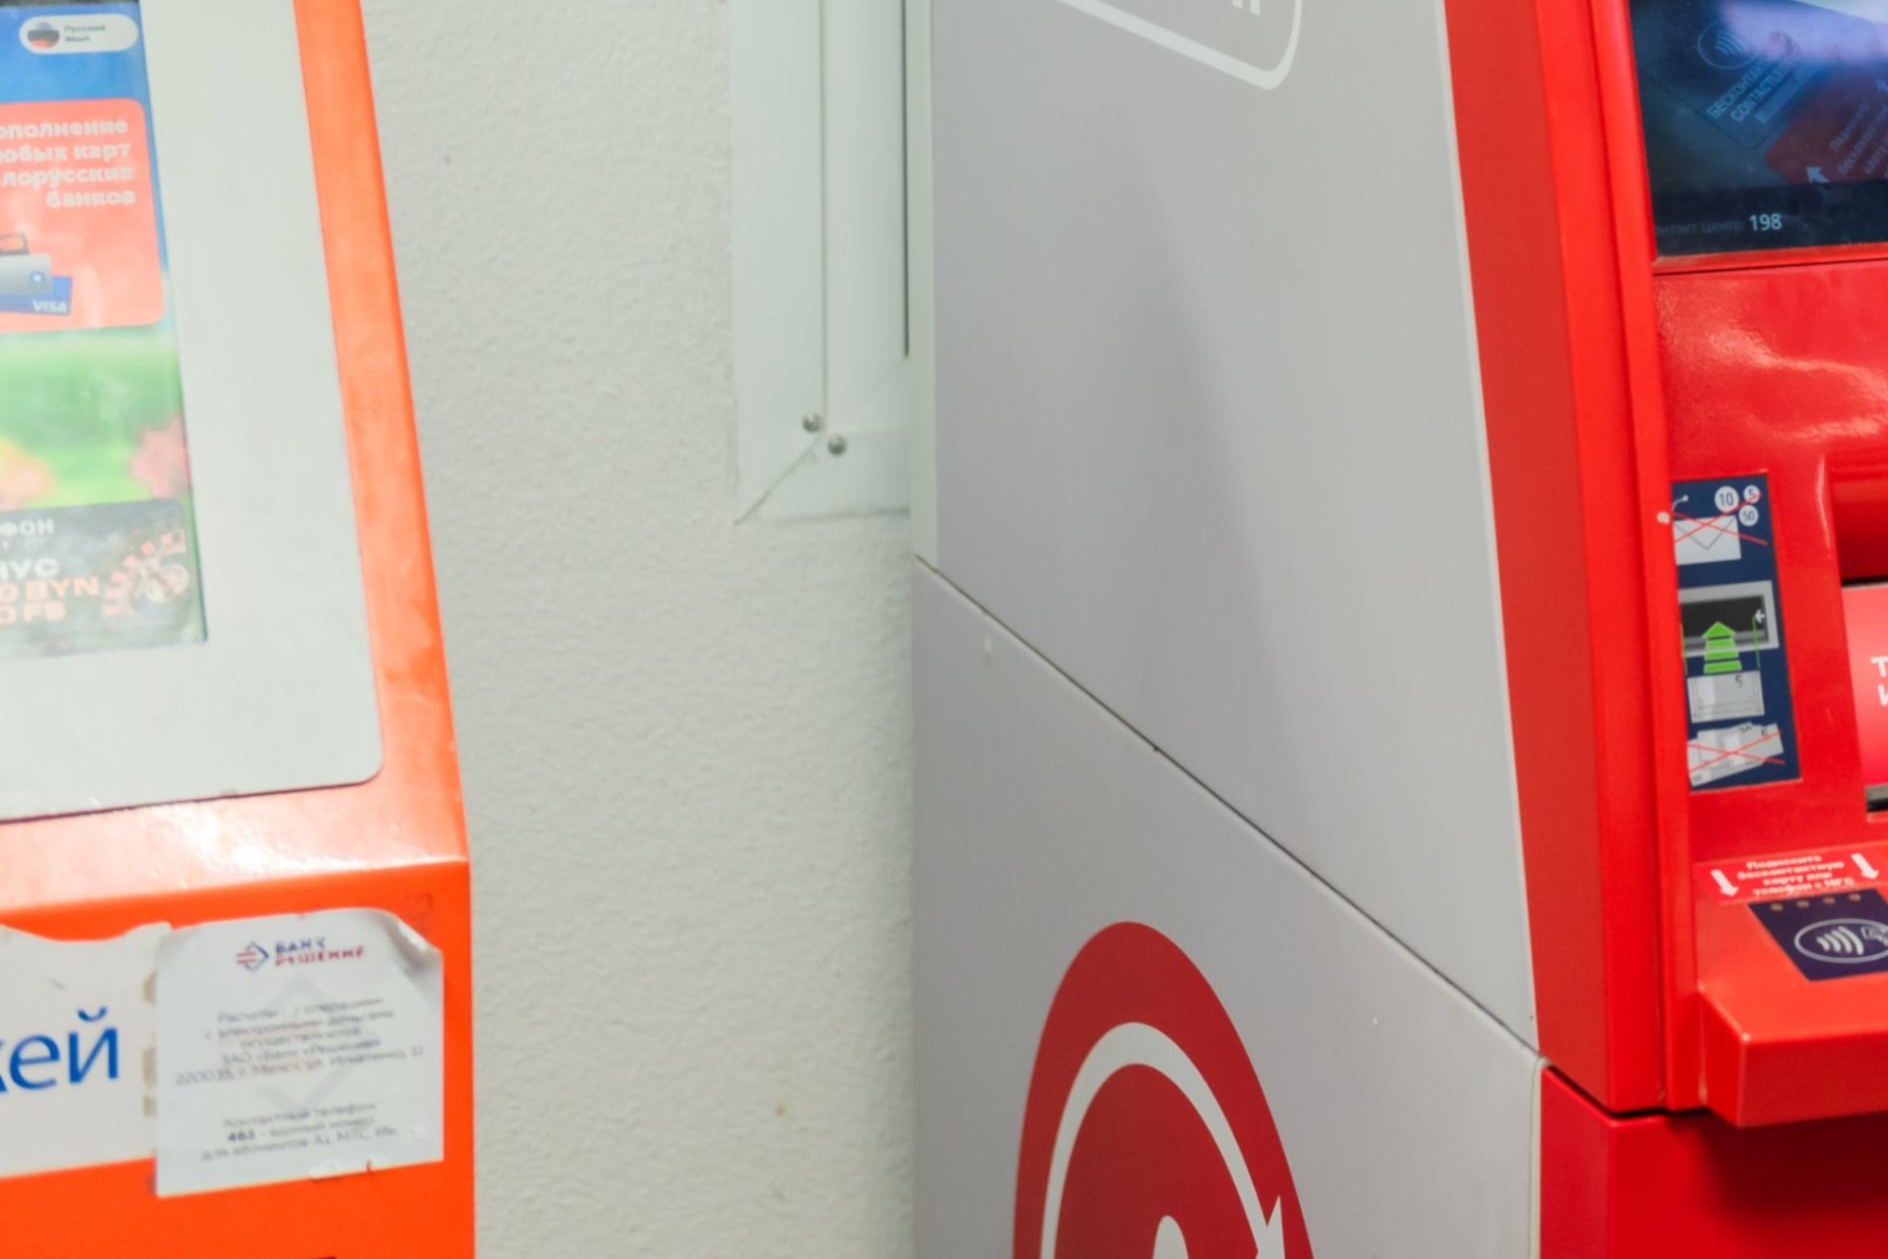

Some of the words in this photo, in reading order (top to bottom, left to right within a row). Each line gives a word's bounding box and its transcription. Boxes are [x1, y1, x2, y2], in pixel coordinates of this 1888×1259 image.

[73, 143, 132, 162] карт
[46, 190, 136, 210] банков
[1749, 212, 1783, 232] 198
[31, 299, 68, 314] VISA
[1718, 491, 1735, 509] 10
[1742, 509, 1756, 522] 50
[1762, 874, 1804, 887] карту
[0, 1007, 120, 1093] ей
